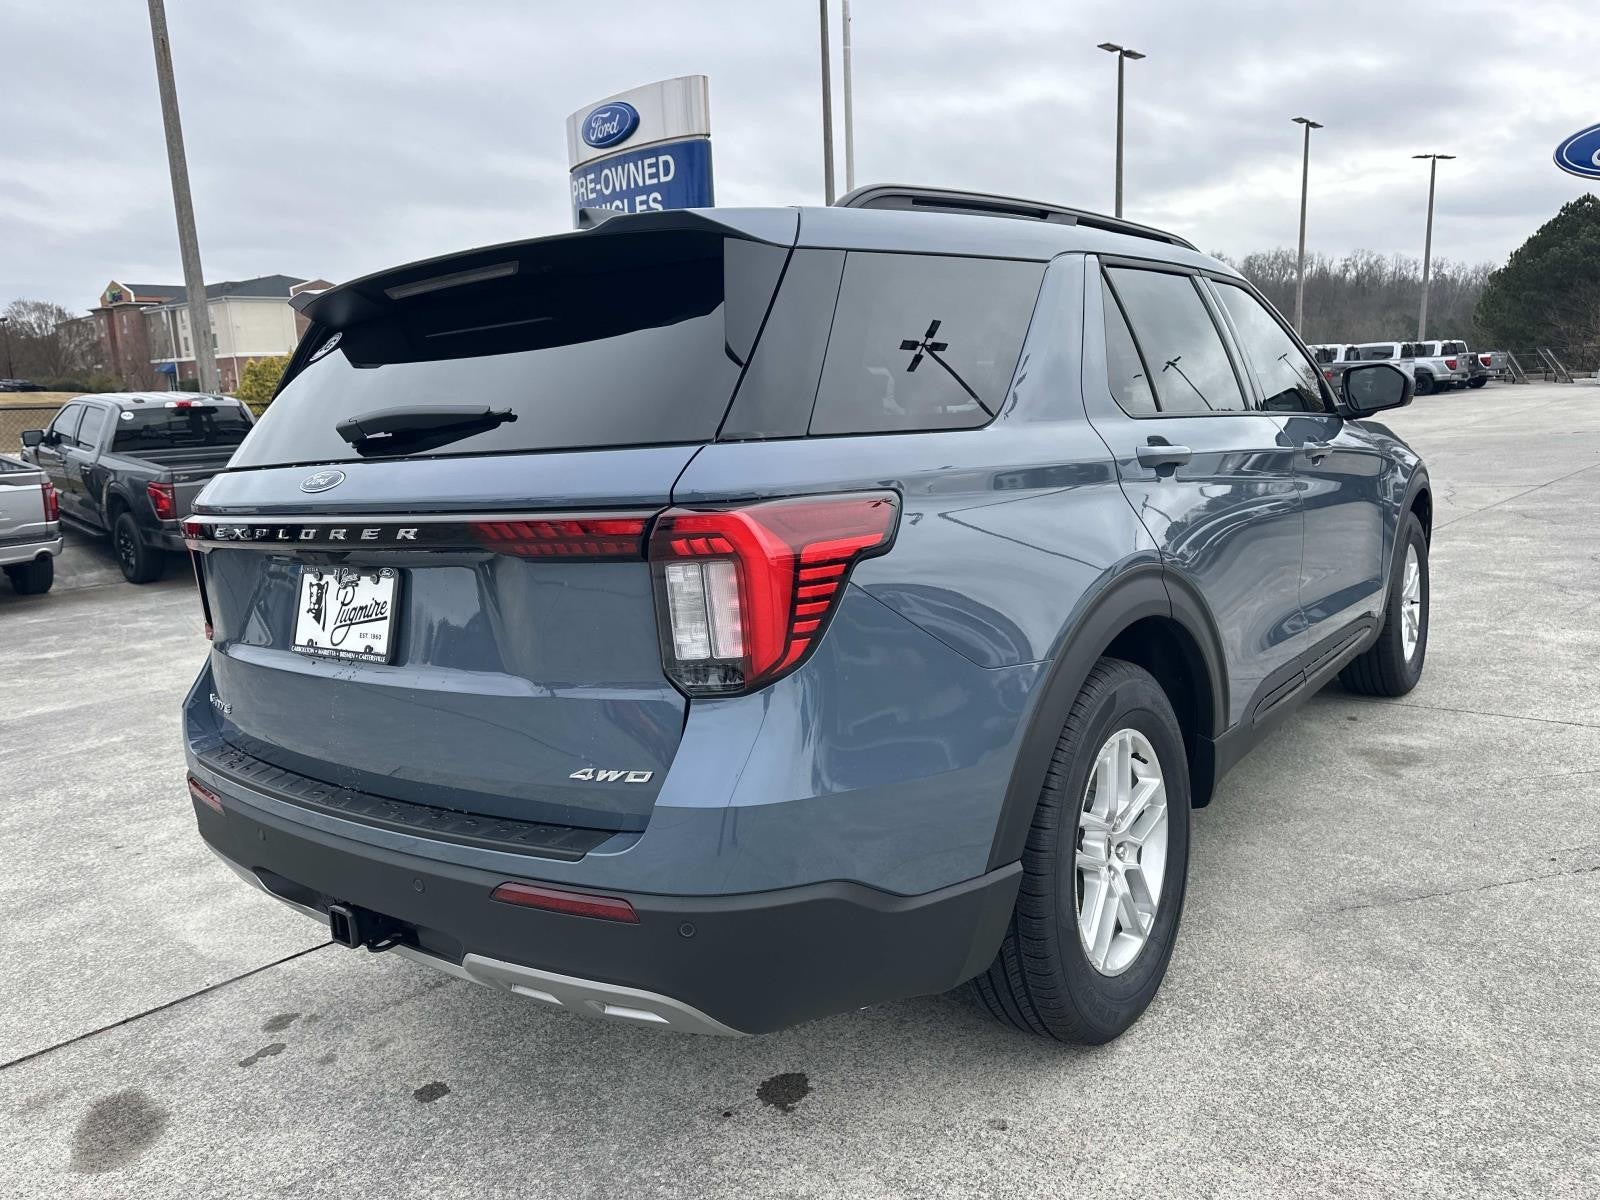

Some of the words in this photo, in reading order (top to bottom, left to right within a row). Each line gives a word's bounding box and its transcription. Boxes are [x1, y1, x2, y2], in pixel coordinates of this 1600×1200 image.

[589, 111, 619, 140] Ford
[572, 154, 675, 204] PRE-OWNED
[215, 527, 418, 540] EXPLORER
[330, 584, 388, 646] Pugmire
[569, 768, 654, 783] 4WD
